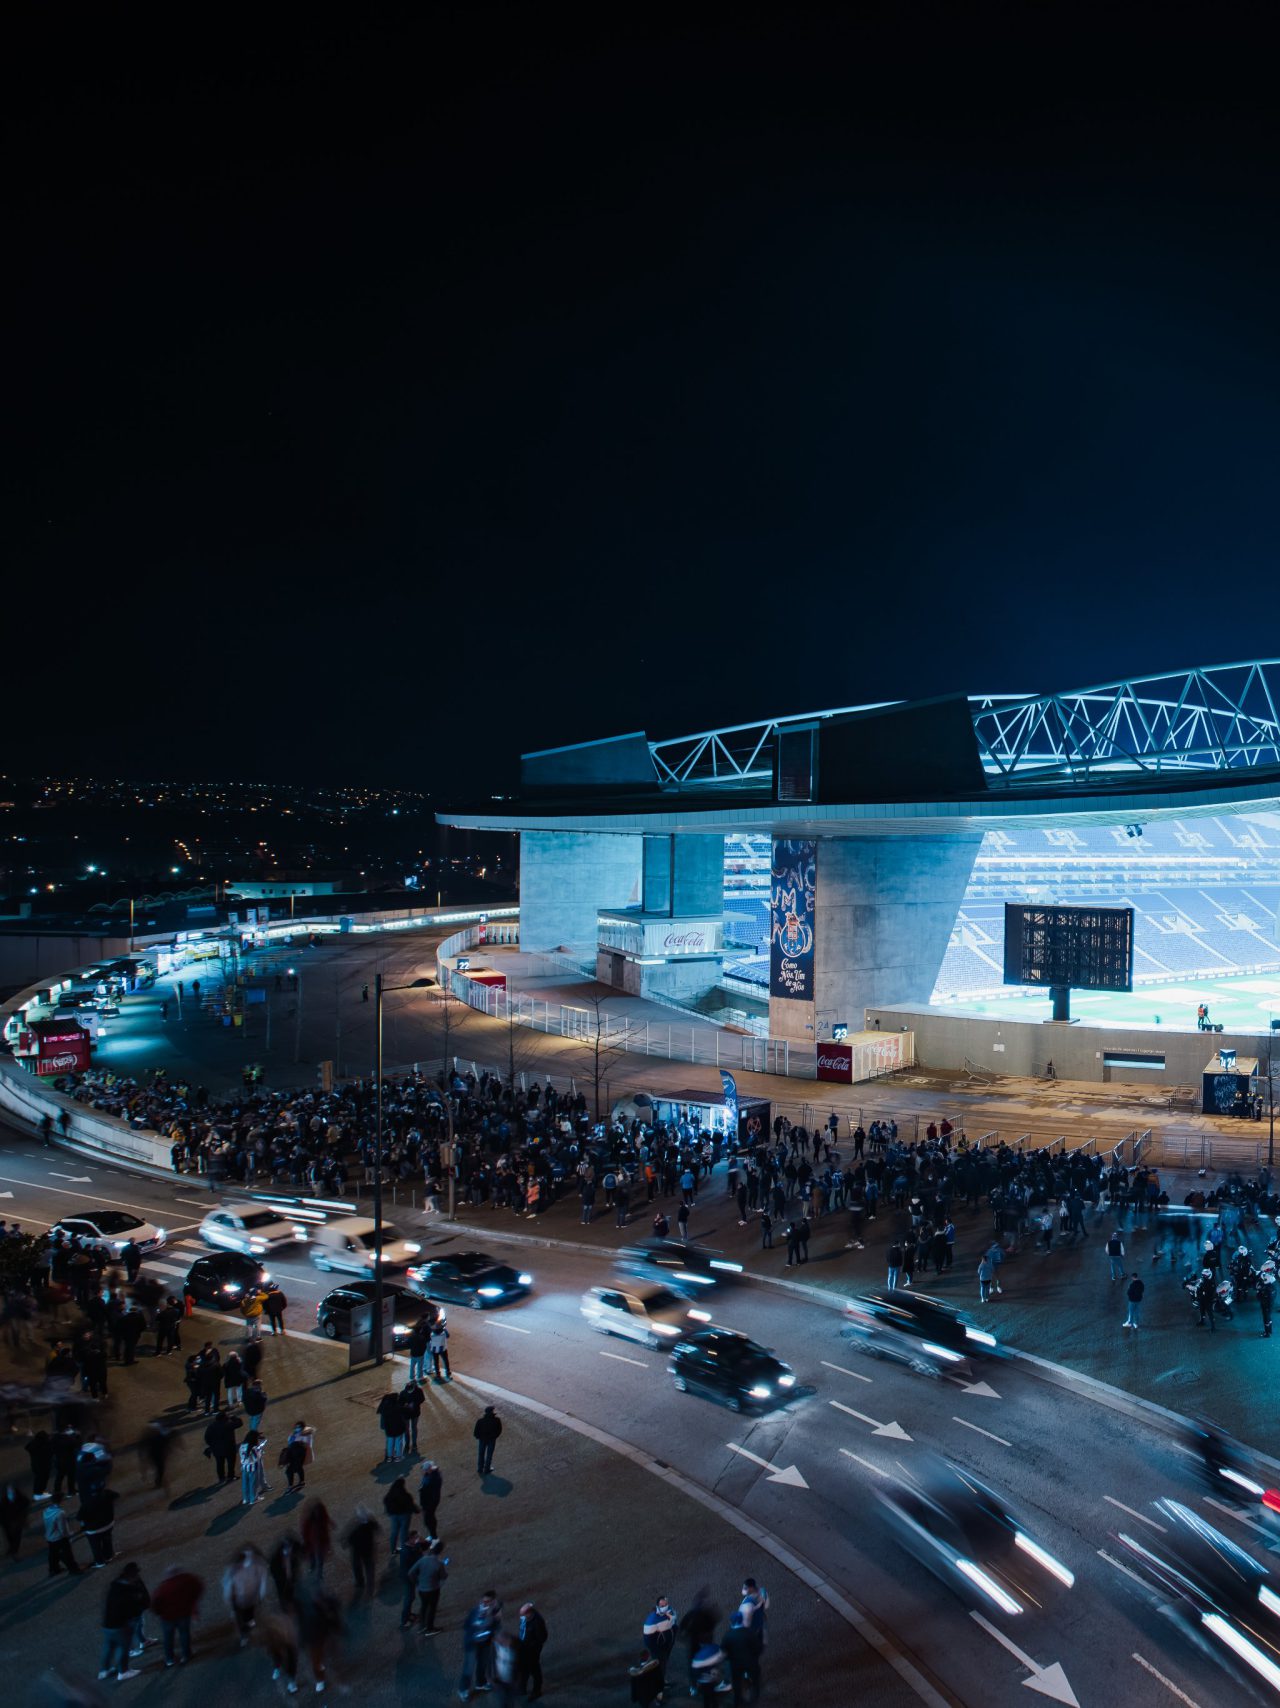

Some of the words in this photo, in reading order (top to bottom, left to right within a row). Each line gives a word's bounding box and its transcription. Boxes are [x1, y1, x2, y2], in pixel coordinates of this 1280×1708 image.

[458, 962, 470, 970] 22
[781, 958, 798, 970] Como
[834, 1028, 848, 1039] 23
